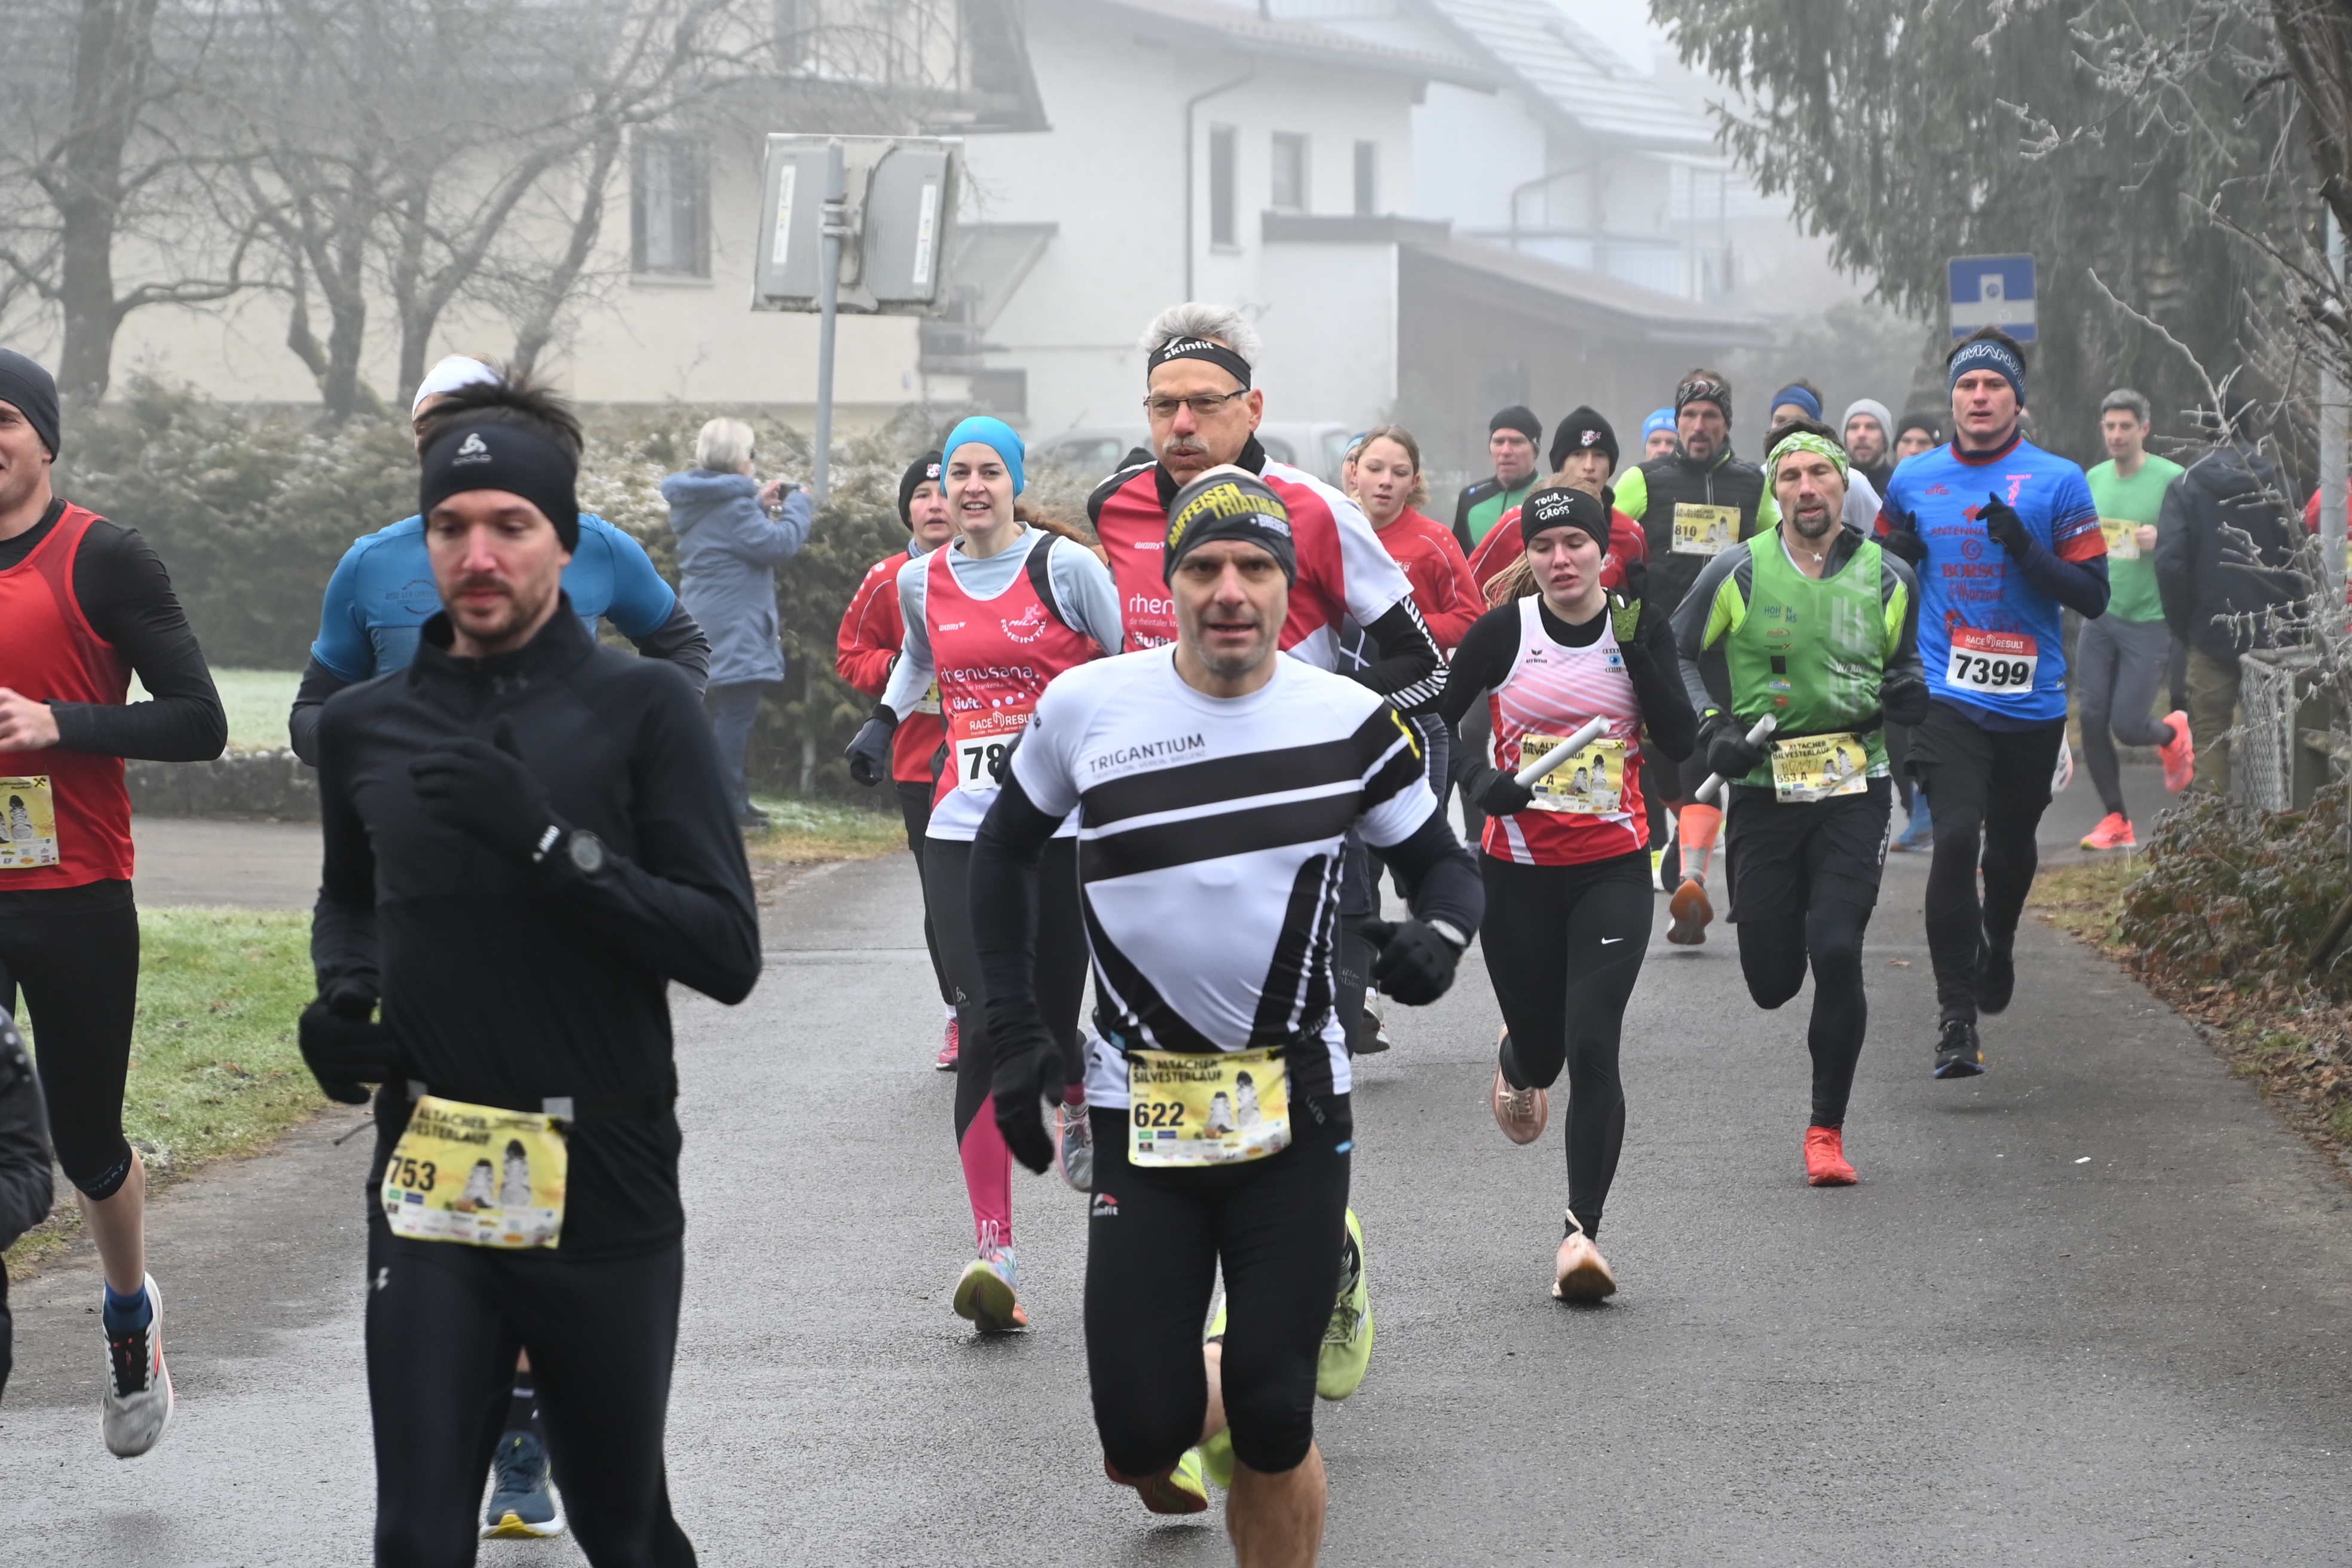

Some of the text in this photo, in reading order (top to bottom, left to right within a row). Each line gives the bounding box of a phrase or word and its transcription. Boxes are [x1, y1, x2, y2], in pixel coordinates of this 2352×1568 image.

[1163, 341, 1214, 360] skinfit
[1535, 492, 1561, 507] TOUR
[1168, 482, 1242, 550] RAIFFEISEN
[1211, 494, 1288, 523] TRIATHLON
[1539, 505, 1570, 520] CROSS
[1674, 524, 1698, 537] 810
[1931, 526, 1986, 535] ANTENNA
[1942, 563, 2006, 578] BORSCI
[1000, 617, 1048, 644] RHEINTAL
[1965, 635, 2024, 650] RACE RESULT
[941, 666, 1033, 683] rhenusana
[1955, 653, 2030, 686] 7399
[969, 713, 1033, 730] RACE RESU
[1089, 733, 1205, 773] TRIGANTIUM
[1788, 740, 1827, 751] ALTACHER
[1777, 771, 1808, 783] 553 A
[1134, 1070, 1223, 1084] SILVESTERLAUF
[1134, 1102, 1185, 1128] 622
[390, 1156, 437, 1191] 753
